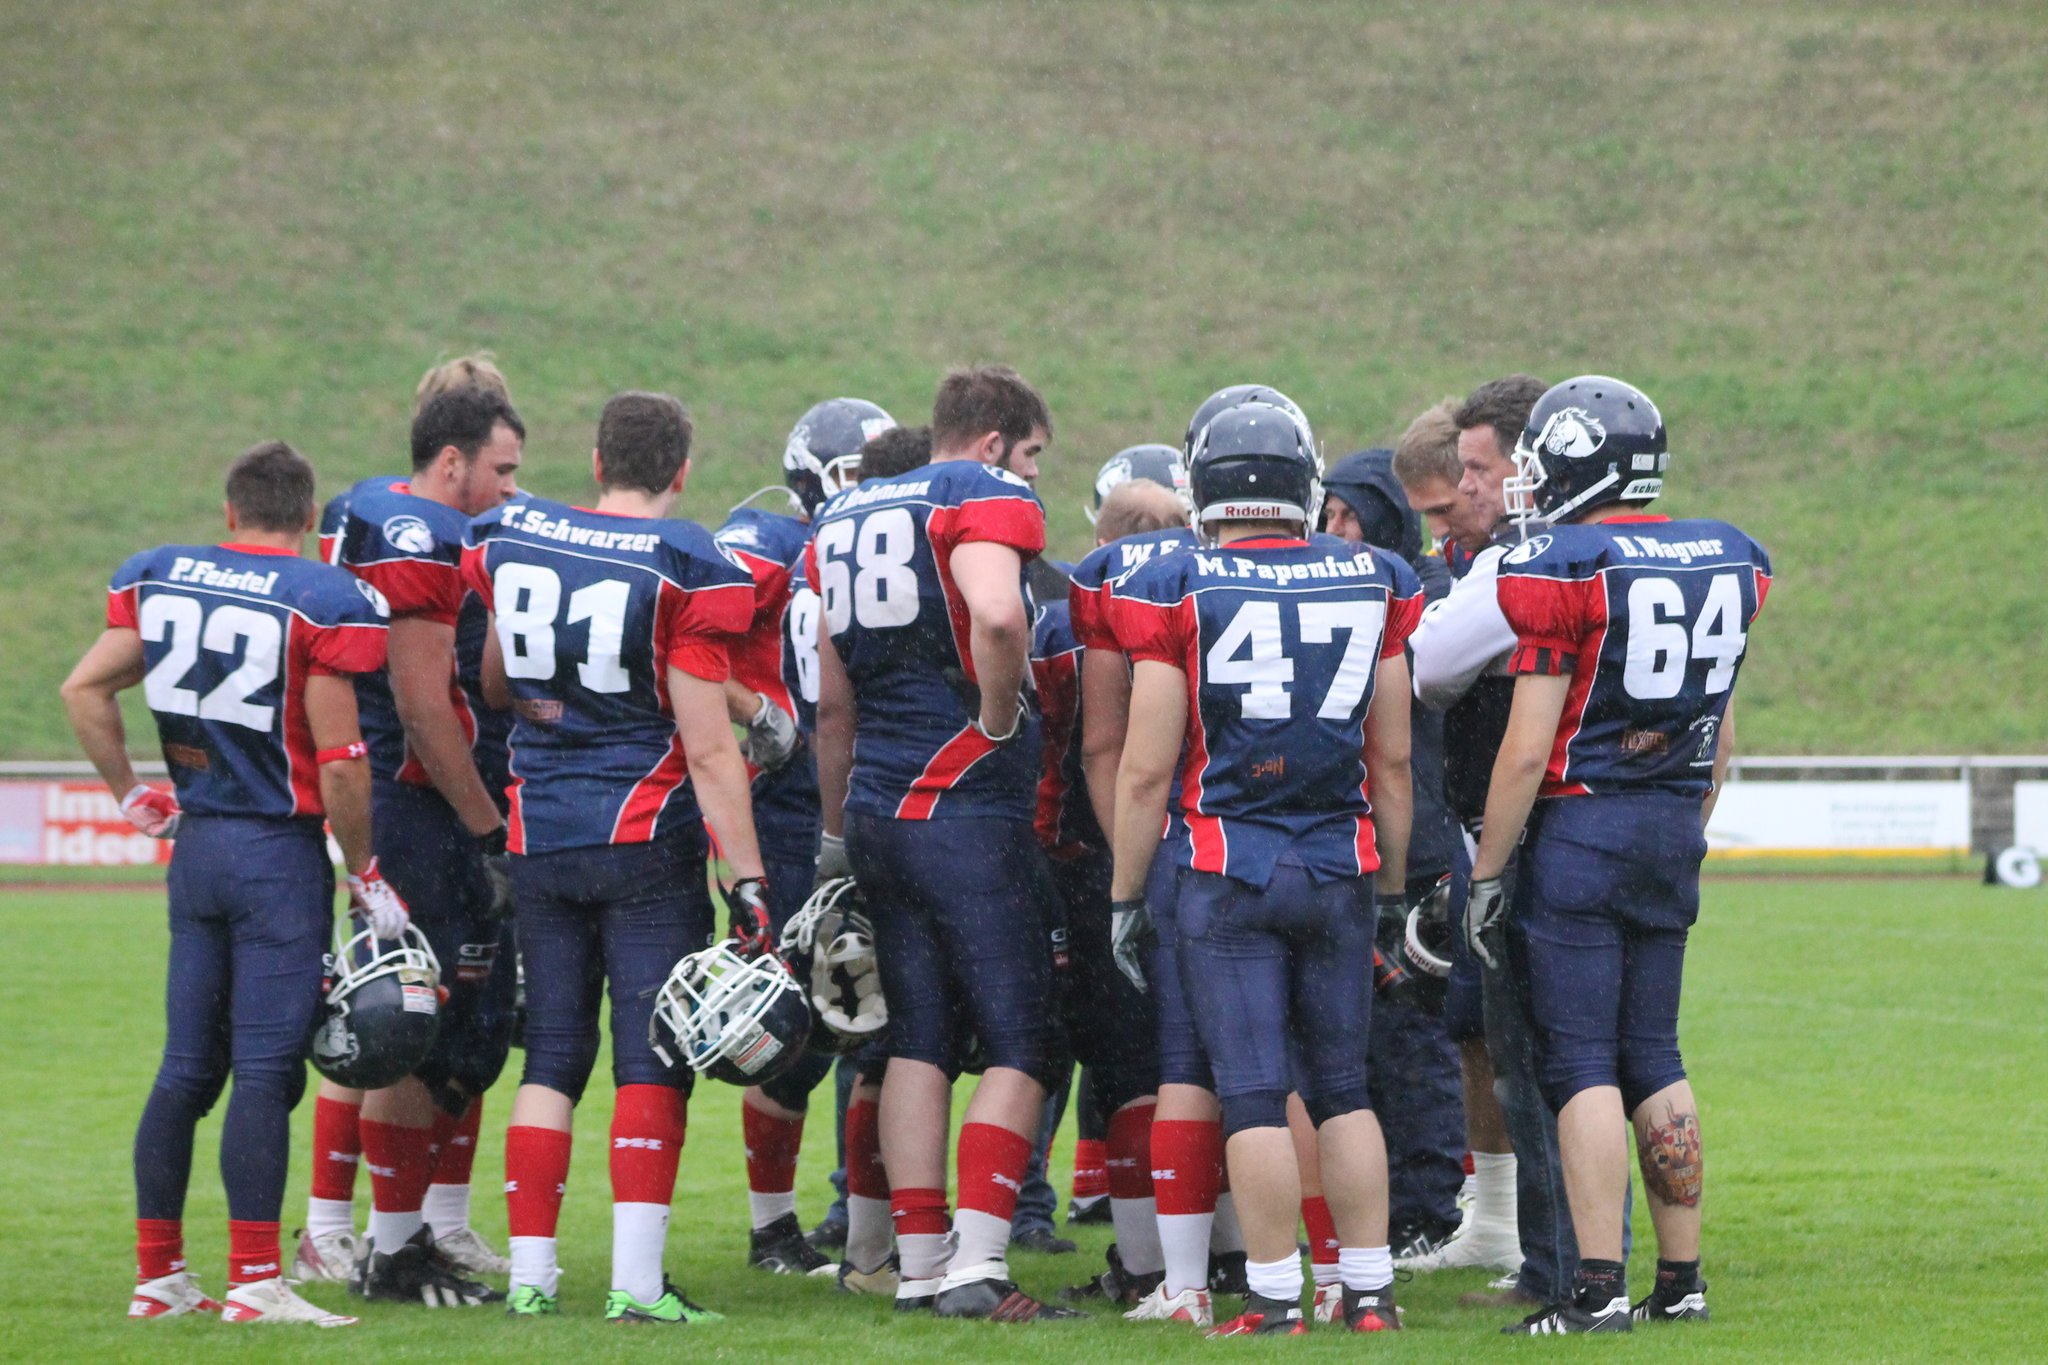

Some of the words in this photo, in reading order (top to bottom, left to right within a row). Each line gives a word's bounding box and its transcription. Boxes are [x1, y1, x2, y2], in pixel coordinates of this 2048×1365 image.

[500, 505, 661, 553] T.Schwarzer
[1224, 506, 1281, 517] Riddell
[1612, 536, 1724, 564] D.Wagner
[168, 557, 279, 595] P.Feistel
[816, 507, 920, 637] 68
[139, 593, 282, 733] 22
[493, 561, 631, 693] 81
[1206, 600, 1386, 720] 47
[1623, 573, 1747, 700] 64
[1357, 1296, 1380, 1308] NIKE
